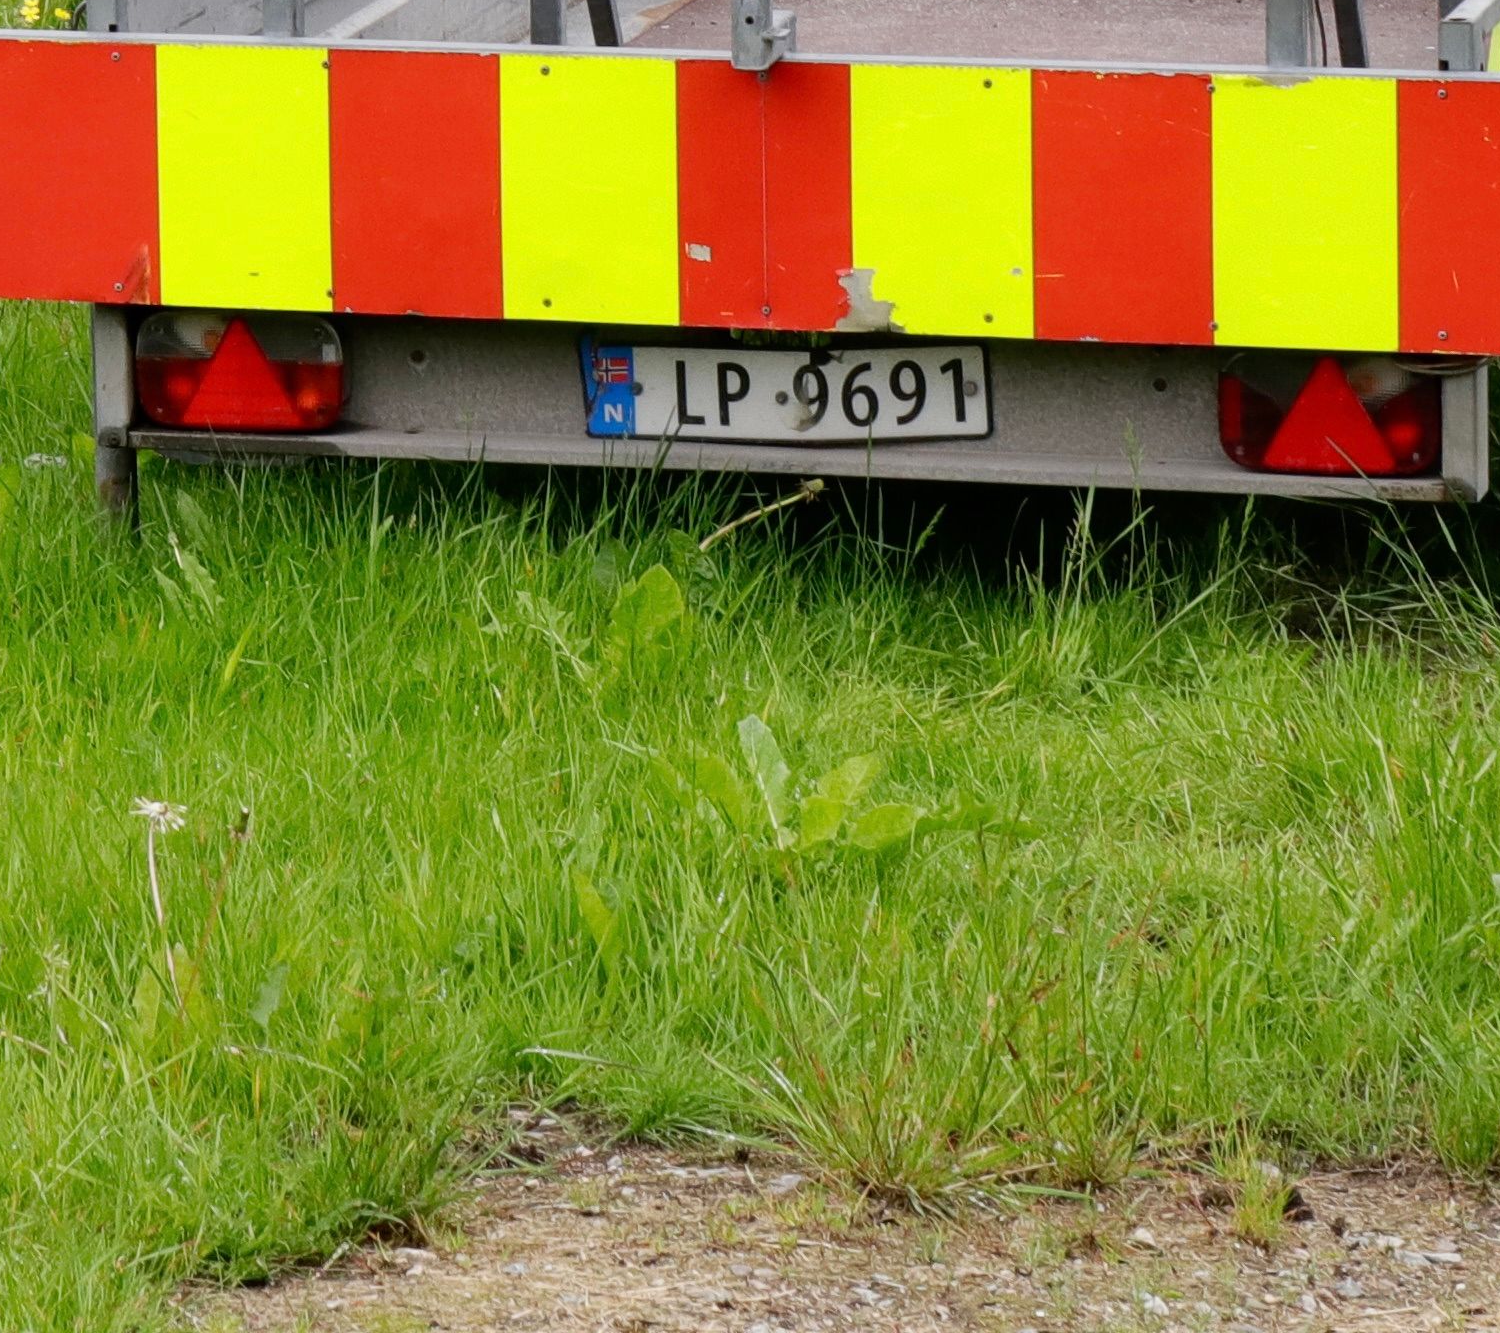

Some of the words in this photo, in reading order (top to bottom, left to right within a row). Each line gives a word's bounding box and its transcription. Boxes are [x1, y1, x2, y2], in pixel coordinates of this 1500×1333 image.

[603, 402, 624, 423] N
[674, 359, 751, 427] LP
[792, 357, 967, 428] 9691
